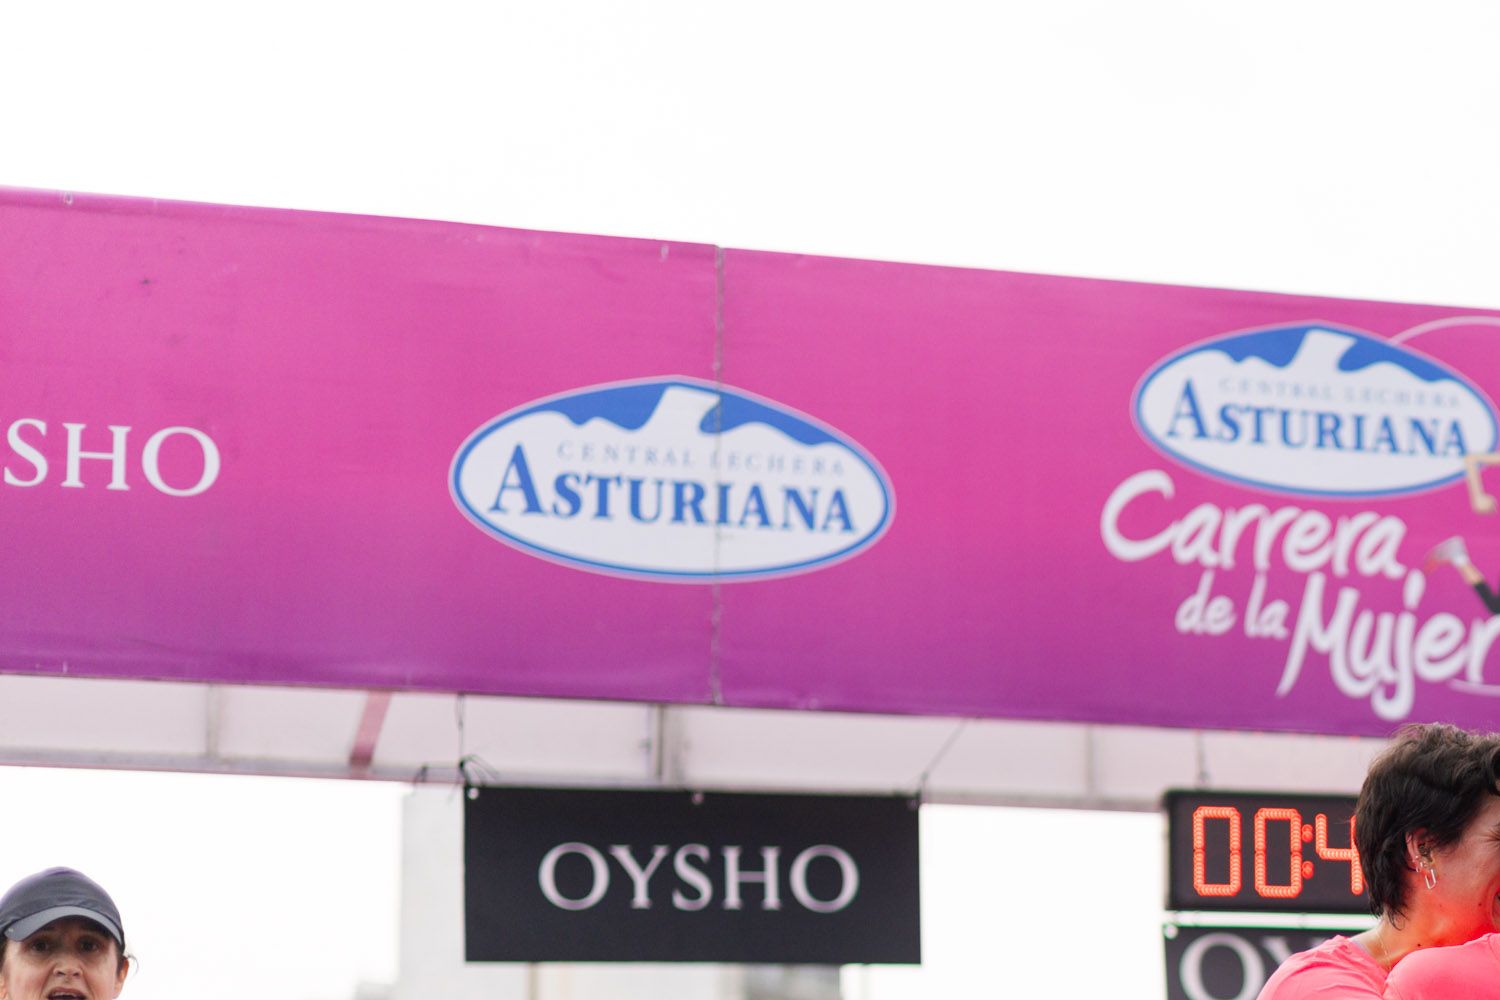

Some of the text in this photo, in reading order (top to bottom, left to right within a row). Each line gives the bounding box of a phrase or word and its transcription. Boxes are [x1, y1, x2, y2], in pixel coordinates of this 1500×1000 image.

[1166, 378, 1469, 459] ASTURIANA
[488, 444, 857, 534] ASTURIANA
[557, 440, 846, 477] CENTRAL LECHERA
[1100, 469, 1409, 580] Carrera
[1175, 570, 1238, 637] de
[1244, 570, 1290, 640] la
[539, 842, 861, 914] OYSHO
